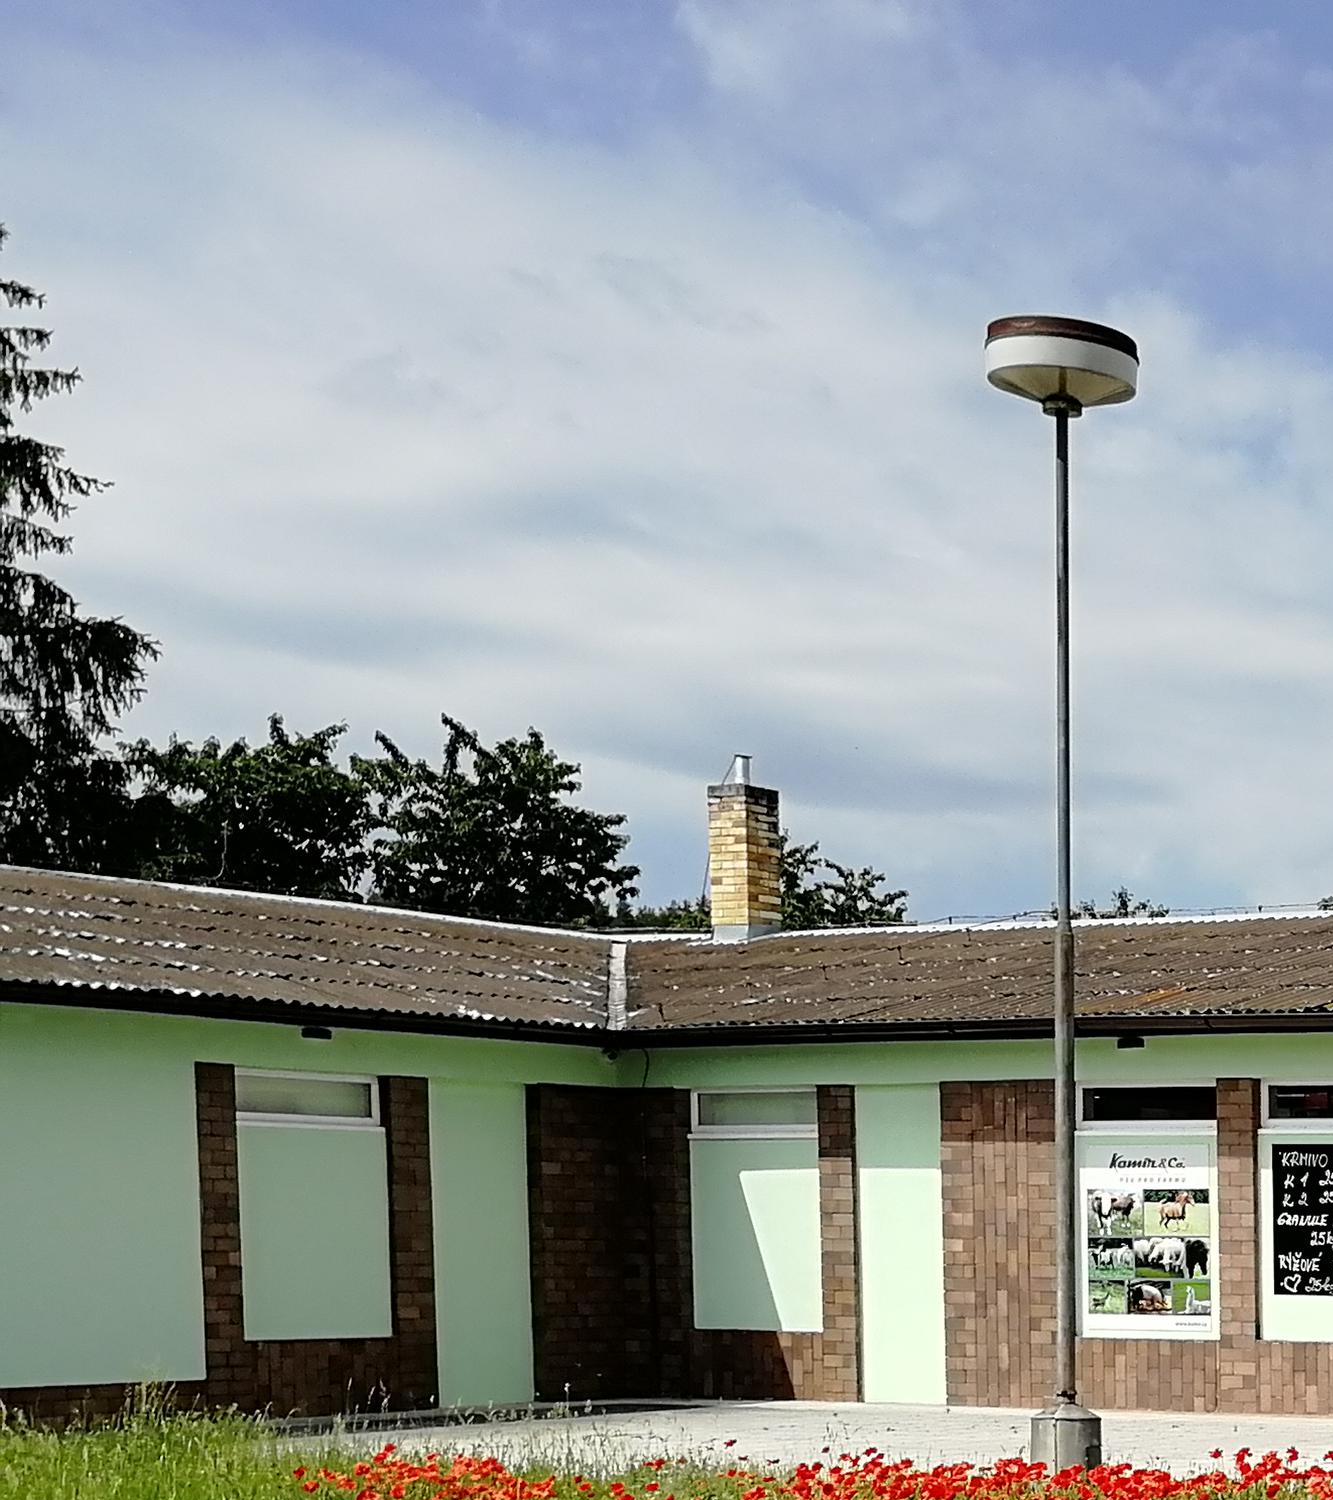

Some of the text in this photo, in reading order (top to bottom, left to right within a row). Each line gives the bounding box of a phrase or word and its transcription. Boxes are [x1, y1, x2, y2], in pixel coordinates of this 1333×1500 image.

[1281, 1151, 1329, 1168] KRMIVO
[1283, 1173, 1295, 1189] K
[1300, 1171, 1310, 1187] 1
[1282, 1193, 1294, 1207] K
[1298, 1192, 1309, 1207] 2
[1277, 1212, 1330, 1227] GRANULE
